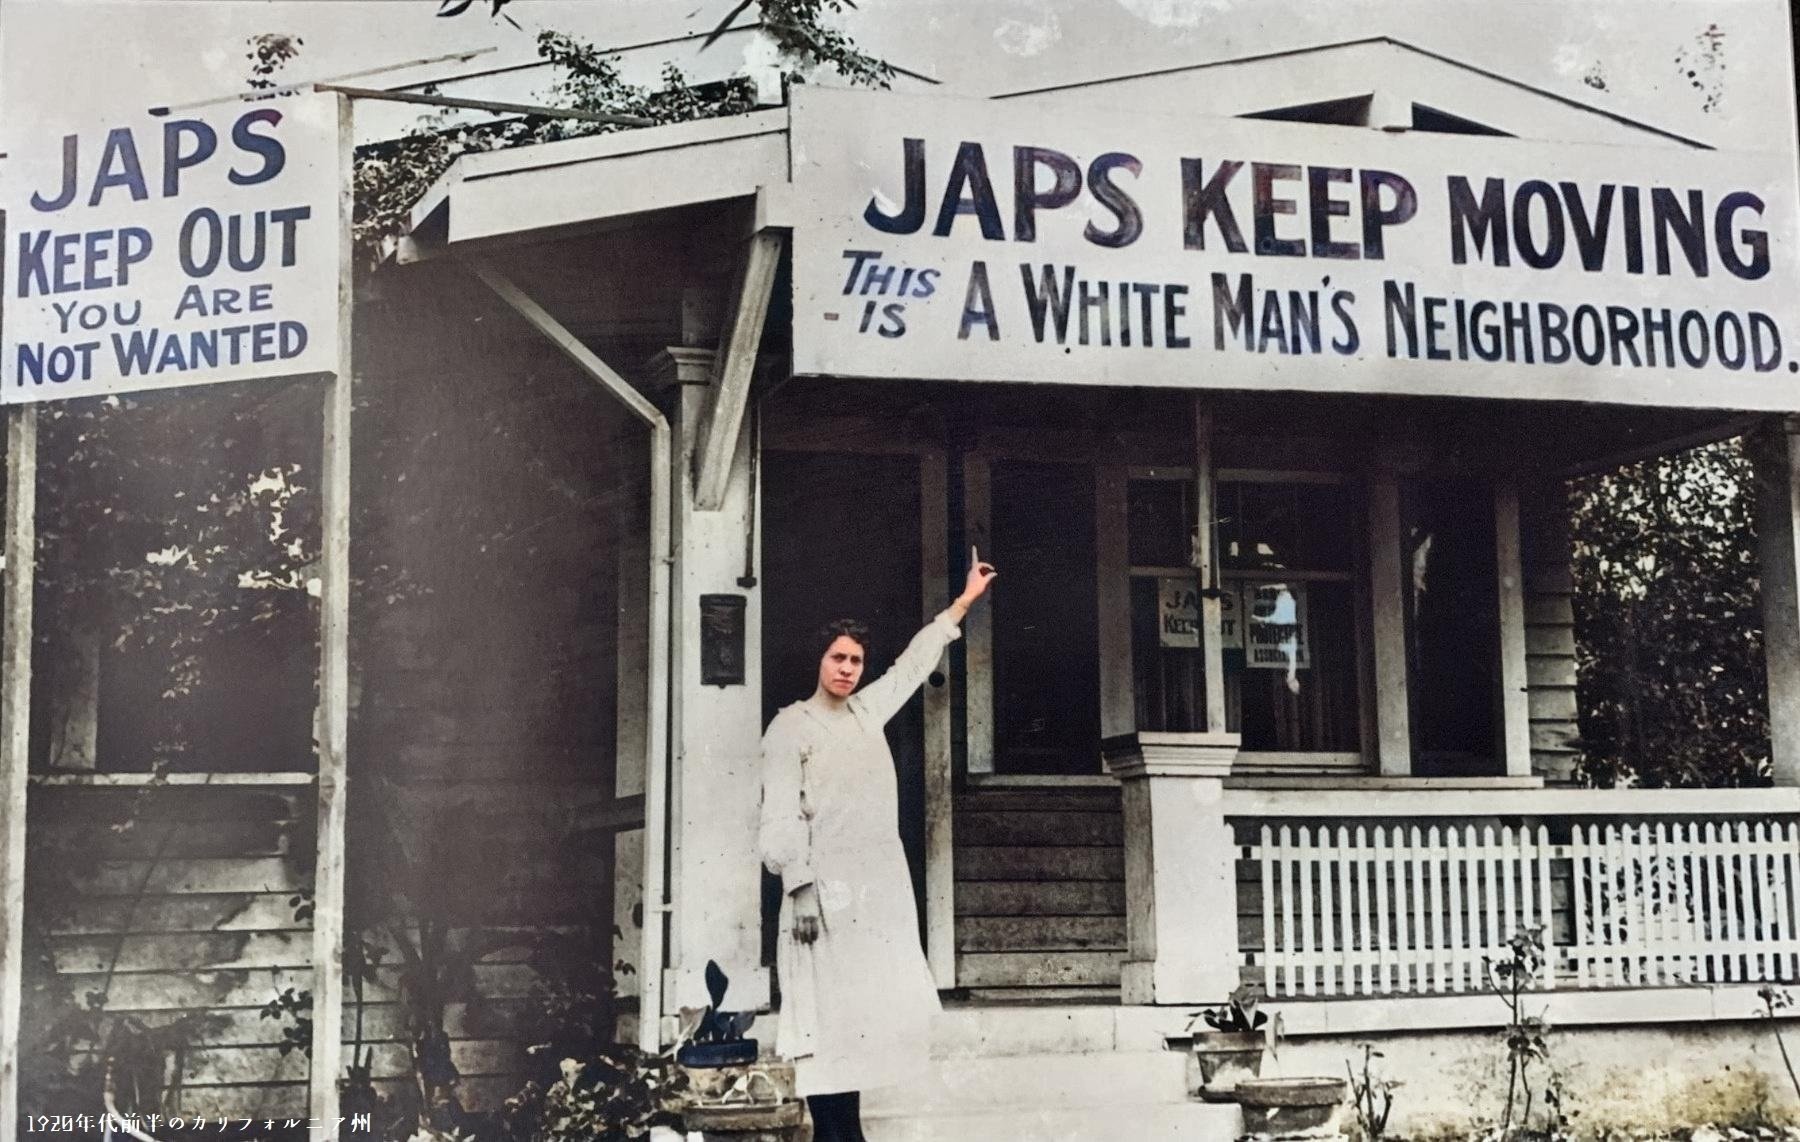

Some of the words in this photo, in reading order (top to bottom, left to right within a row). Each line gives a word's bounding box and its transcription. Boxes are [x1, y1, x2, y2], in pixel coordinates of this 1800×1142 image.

[30, 108, 287, 212] JAPS
[863, 137, 1144, 248] JAPS
[1181, 157, 1418, 261] KEEP
[1447, 175, 1772, 281] MOVING
[17, 226, 153, 298] KEEP
[179, 206, 311, 278] OUT
[842, 250, 941, 298] THIS
[52, 300, 142, 334] YOU
[174, 284, 274, 320] ARE
[859, 301, 907, 338] IS
[957, 260, 1000, 341] A
[1019, 263, 1191, 349] WHITE
[1210, 272, 1360, 355] MAN'S
[1383, 280, 1799, 374] NEIGHBORHOOD.
[17, 342, 101, 387] NOT
[111, 320, 308, 377] WANTED
[1165, 590, 1233, 611] JAS
